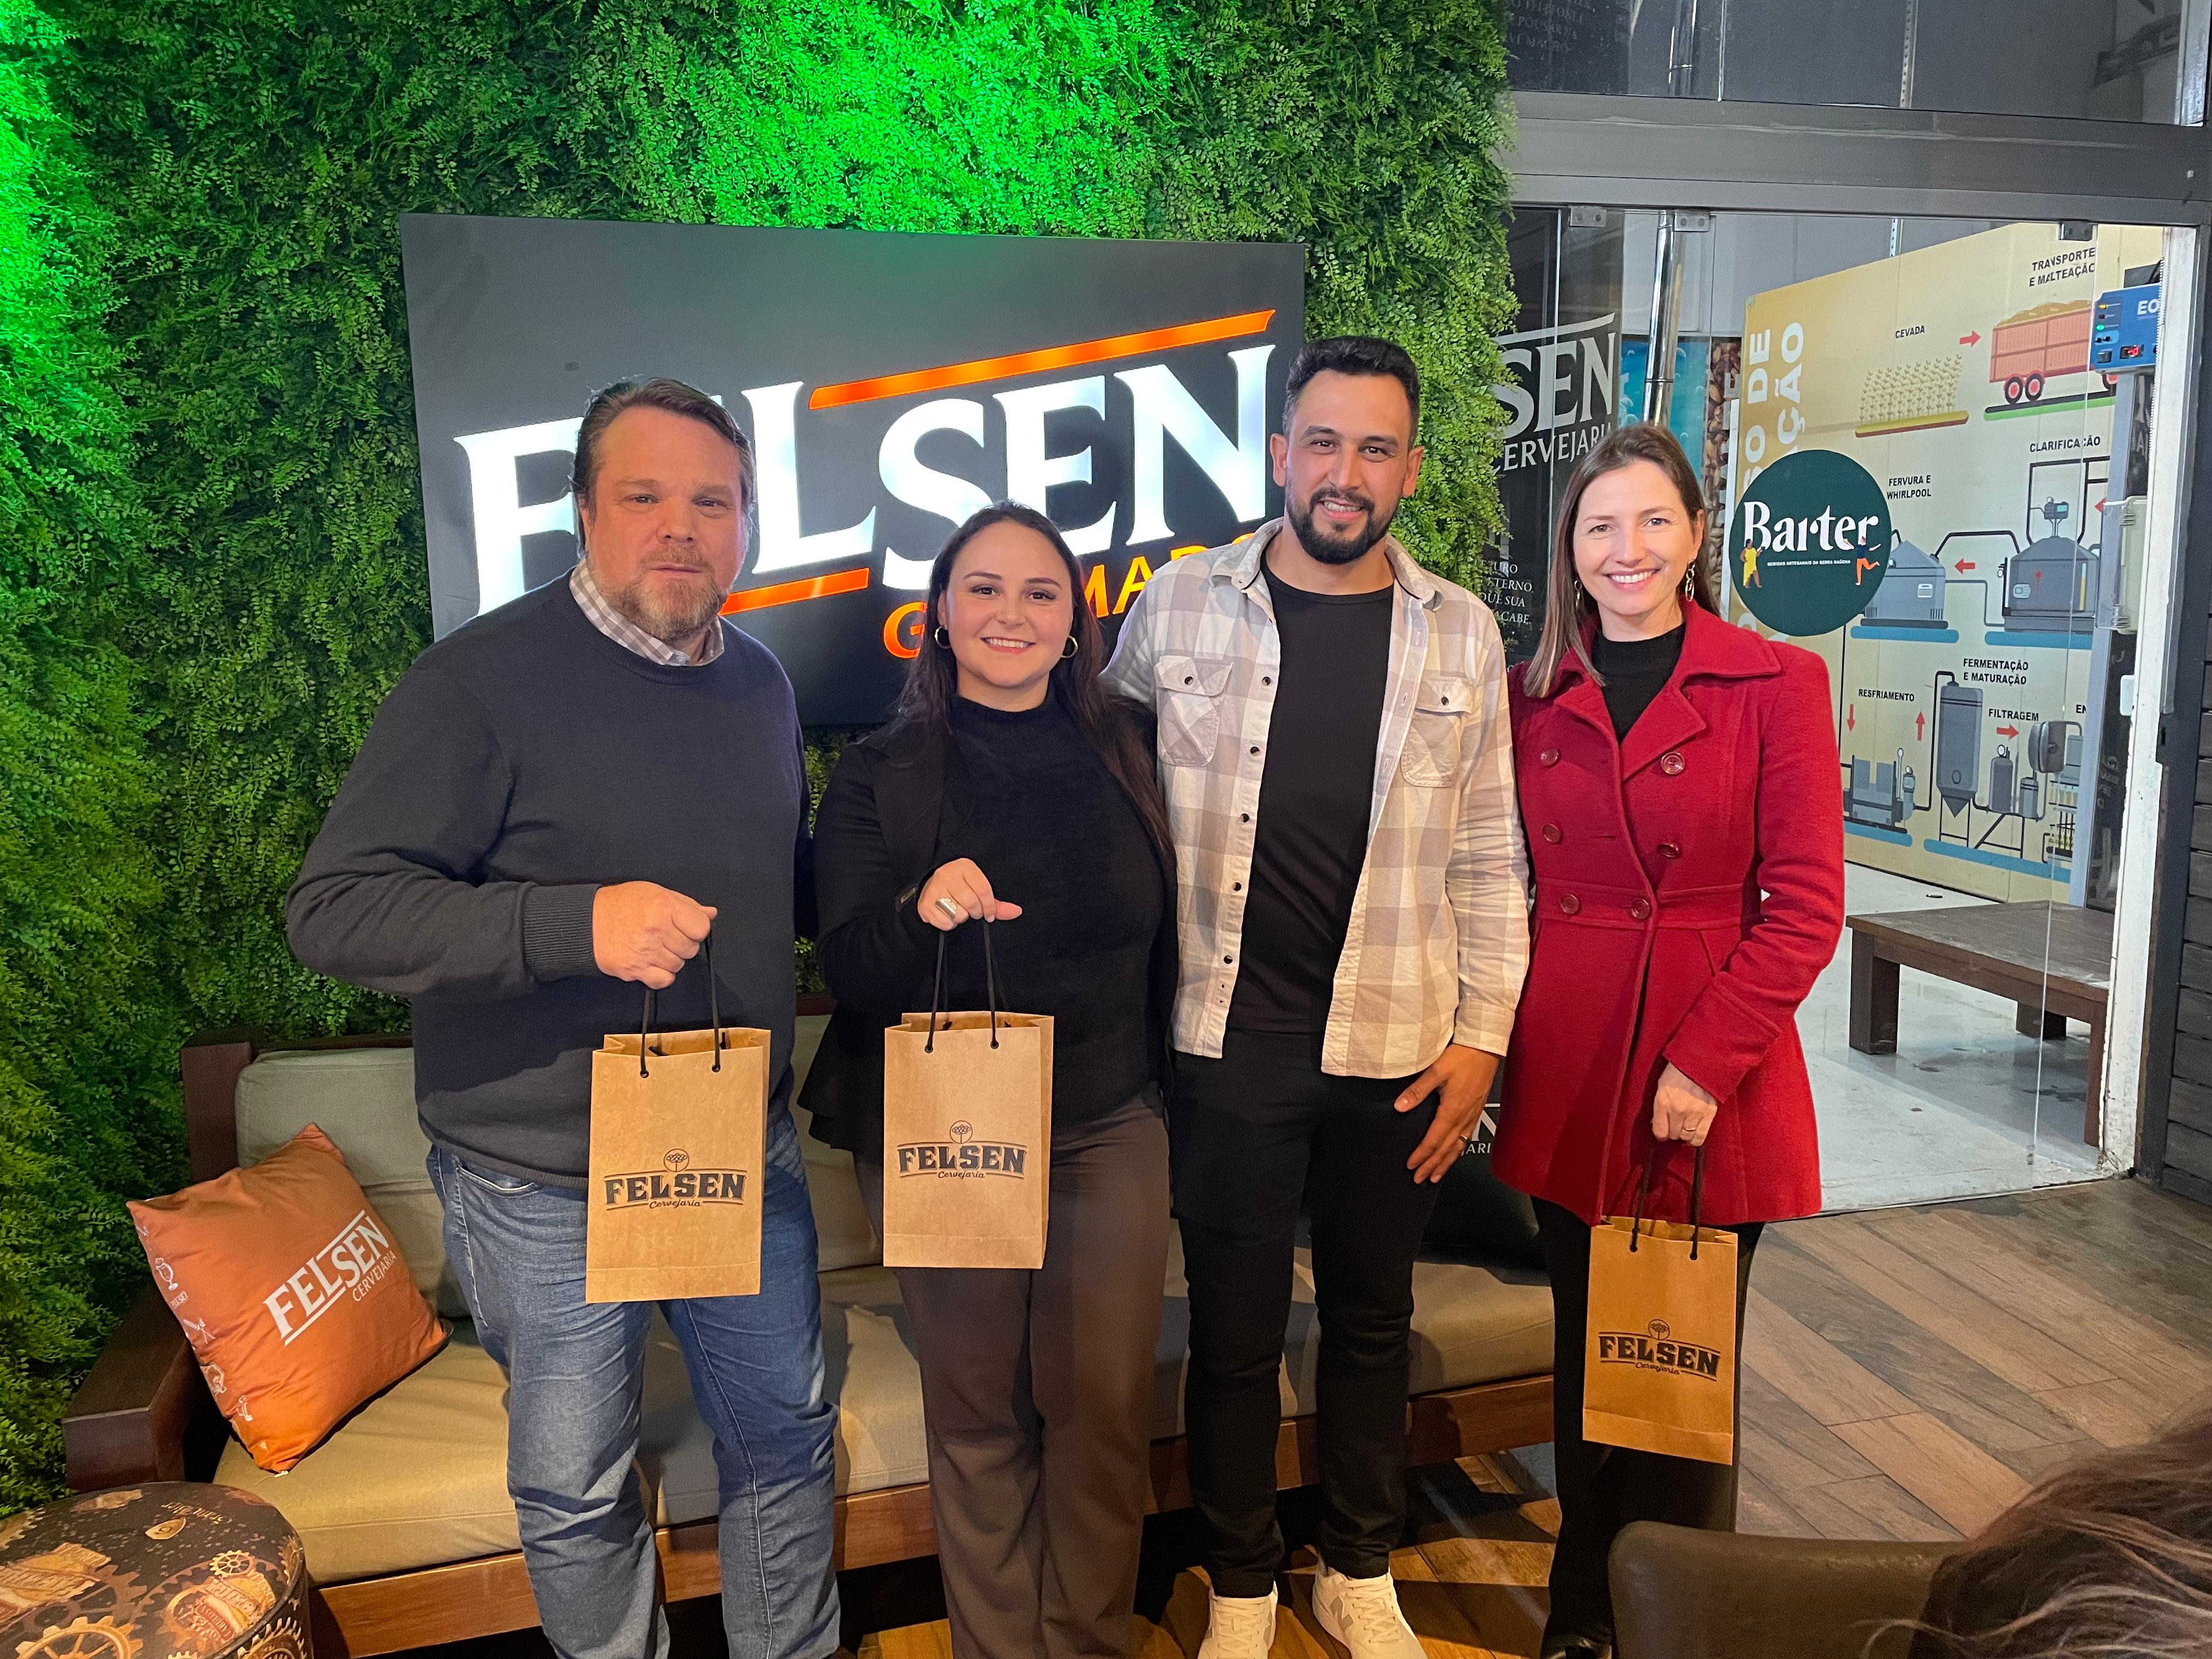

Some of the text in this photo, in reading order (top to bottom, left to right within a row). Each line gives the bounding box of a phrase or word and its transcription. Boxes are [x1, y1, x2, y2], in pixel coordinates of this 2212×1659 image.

[2032, 247, 2096, 271] TRANSPORTE
[2029, 277, 2035, 287] E
[1895, 325, 1925, 338] CEVADA
[1747, 329, 1770, 404] DE
[2030, 435, 2101, 452] CLARIFICAÃO
[454, 345, 1276, 615] FLSEN
[1888, 475, 1931, 487] FERVURA E
[1887, 489, 1932, 500] WHIRLPOOL
[1744, 501, 1879, 552] Barter
[1504, 596, 1525, 607] SUA
[1963, 658, 2029, 672] FERMENTAÇÃO
[1963, 672, 2027, 686] E MATURAÇÃO
[1858, 689, 1915, 702] RESFRIAMENTO
[1989, 708, 2039, 721] FILTRAGEM
[898, 1146, 1026, 1173] FELSEN
[938, 1171, 985, 1180] Cervejaria
[605, 1173, 747, 1205] FELSEN
[650, 1199, 702, 1209] Cervejaria
[262, 1216, 390, 1339] FELSEN
[352, 1250, 397, 1301] CERVEJARIA
[1599, 1336, 1719, 1377] FELSEN
